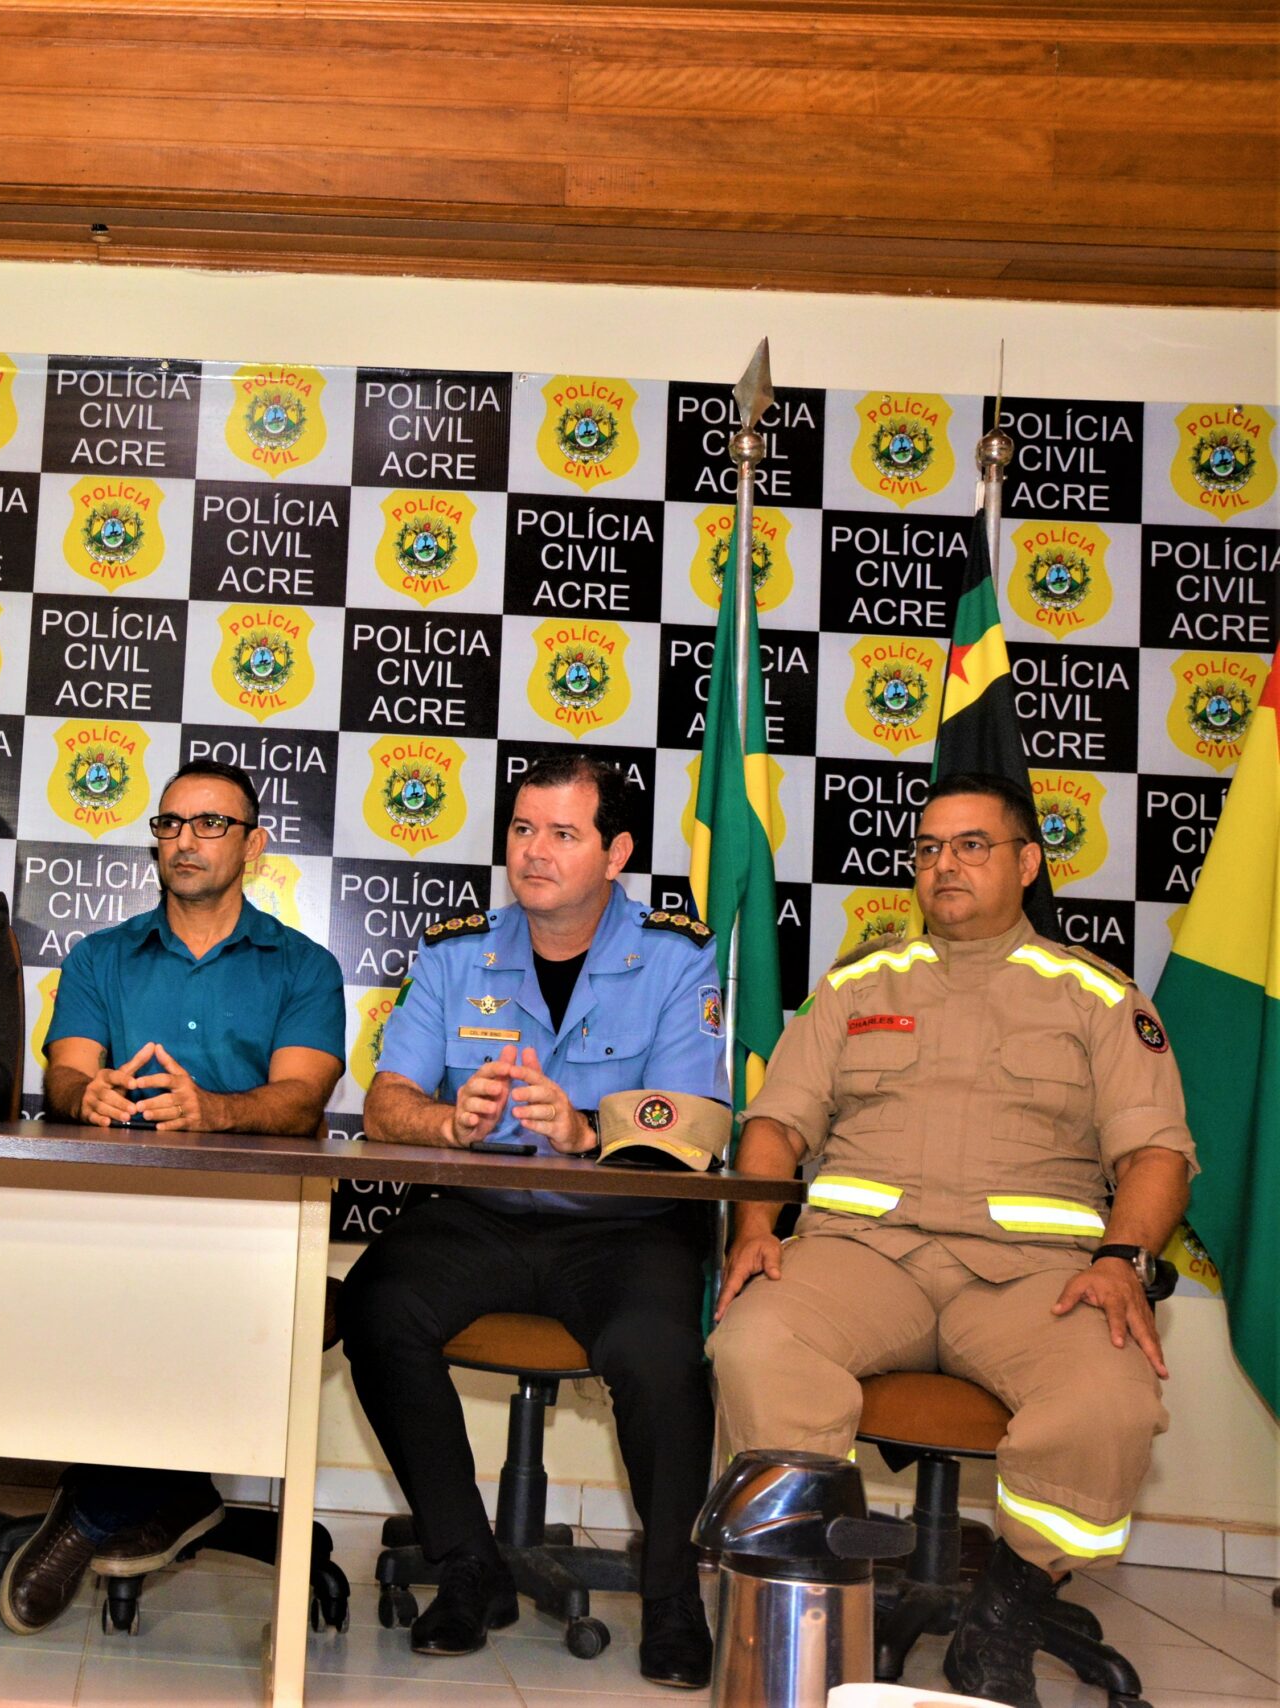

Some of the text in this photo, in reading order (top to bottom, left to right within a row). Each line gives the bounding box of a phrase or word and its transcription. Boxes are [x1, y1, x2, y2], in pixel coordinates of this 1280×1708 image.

[56, 366, 189, 399] POLÍCIA
[241, 367, 314, 397] POLÍCIA
[366, 379, 500, 413] POLÍCIA
[552, 381, 626, 411] POLÍCIA
[79, 401, 162, 430] CIVIL
[679, 393, 815, 427] POLCIA
[867, 395, 941, 426] POLÍCIA
[389, 415, 473, 443] CIVIL
[1183, 411, 1257, 442] POLÍCIA
[70, 437, 165, 466] ACRE
[250, 446, 301, 465] CIVIL
[380, 451, 476, 480] ACRE
[1018, 444, 1104, 473] CIVIL
[563, 460, 614, 479] CIVIL
[79, 480, 152, 511] POLÍCIA
[879, 475, 930, 495] CIVIL
[1011, 481, 1108, 510] ACRE
[204, 493, 338, 527] POLÍCIA
[390, 494, 464, 525] POLÍCIA
[1195, 491, 1247, 511] CIVIL
[517, 507, 653, 542] POLÍCIA
[705, 509, 780, 540] POCIA
[833, 522, 970, 557] POLÍCIA
[227, 528, 311, 558] CIVIL
[1023, 525, 1098, 556] POLÍCIA
[88, 560, 139, 579] CIVIL
[540, 543, 626, 573] CIVIL
[857, 558, 943, 588] CIVIL
[218, 565, 314, 594] ACRE
[400, 575, 452, 594] CIVIL
[1176, 575, 1262, 605] CIVIL
[532, 580, 629, 610] ACRE
[41, 607, 175, 641] POLÍCIA
[227, 609, 301, 640] POLÍCIA
[850, 596, 947, 626] ACRE
[1035, 606, 1087, 626] CIVIL
[354, 622, 490, 657] POLÍCIA
[542, 624, 617, 655] POLÍCIA
[1169, 612, 1266, 643] ACRE
[64, 643, 148, 672] CIVIL
[670, 637, 808, 673] POCIA
[861, 640, 936, 672] POLÍCIA
[377, 658, 462, 688] CIVIL
[1012, 654, 1127, 690] OLÍCIA
[1180, 657, 1256, 689] POLÍCIA
[55, 680, 151, 710] ACRE
[237, 690, 288, 710] CIVIL
[1015, 691, 1101, 721] CIVIL
[368, 695, 465, 726] ACRE
[553, 706, 605, 726] CIVIL
[64, 724, 138, 755] POLÍCIA
[686, 712, 784, 742] AE
[872, 722, 924, 743] CIVIL
[378, 740, 453, 772] POLÍCIA
[250, 774, 298, 805] VIL
[826, 771, 929, 806] POLÍC
[1032, 776, 1091, 807] OLÍCIA
[72, 806, 124, 826] CIVIL
[258, 812, 301, 843] RE
[850, 808, 922, 839] CIVI
[388, 823, 440, 843] CIVIL
[25, 854, 160, 890] POLÍCIA
[244, 859, 287, 889] LÍCIA
[843, 847, 916, 878] ACR
[341, 872, 478, 908] POLÍCIA
[48, 891, 128, 923] CIVIL
[854, 895, 911, 921] POLÍC
